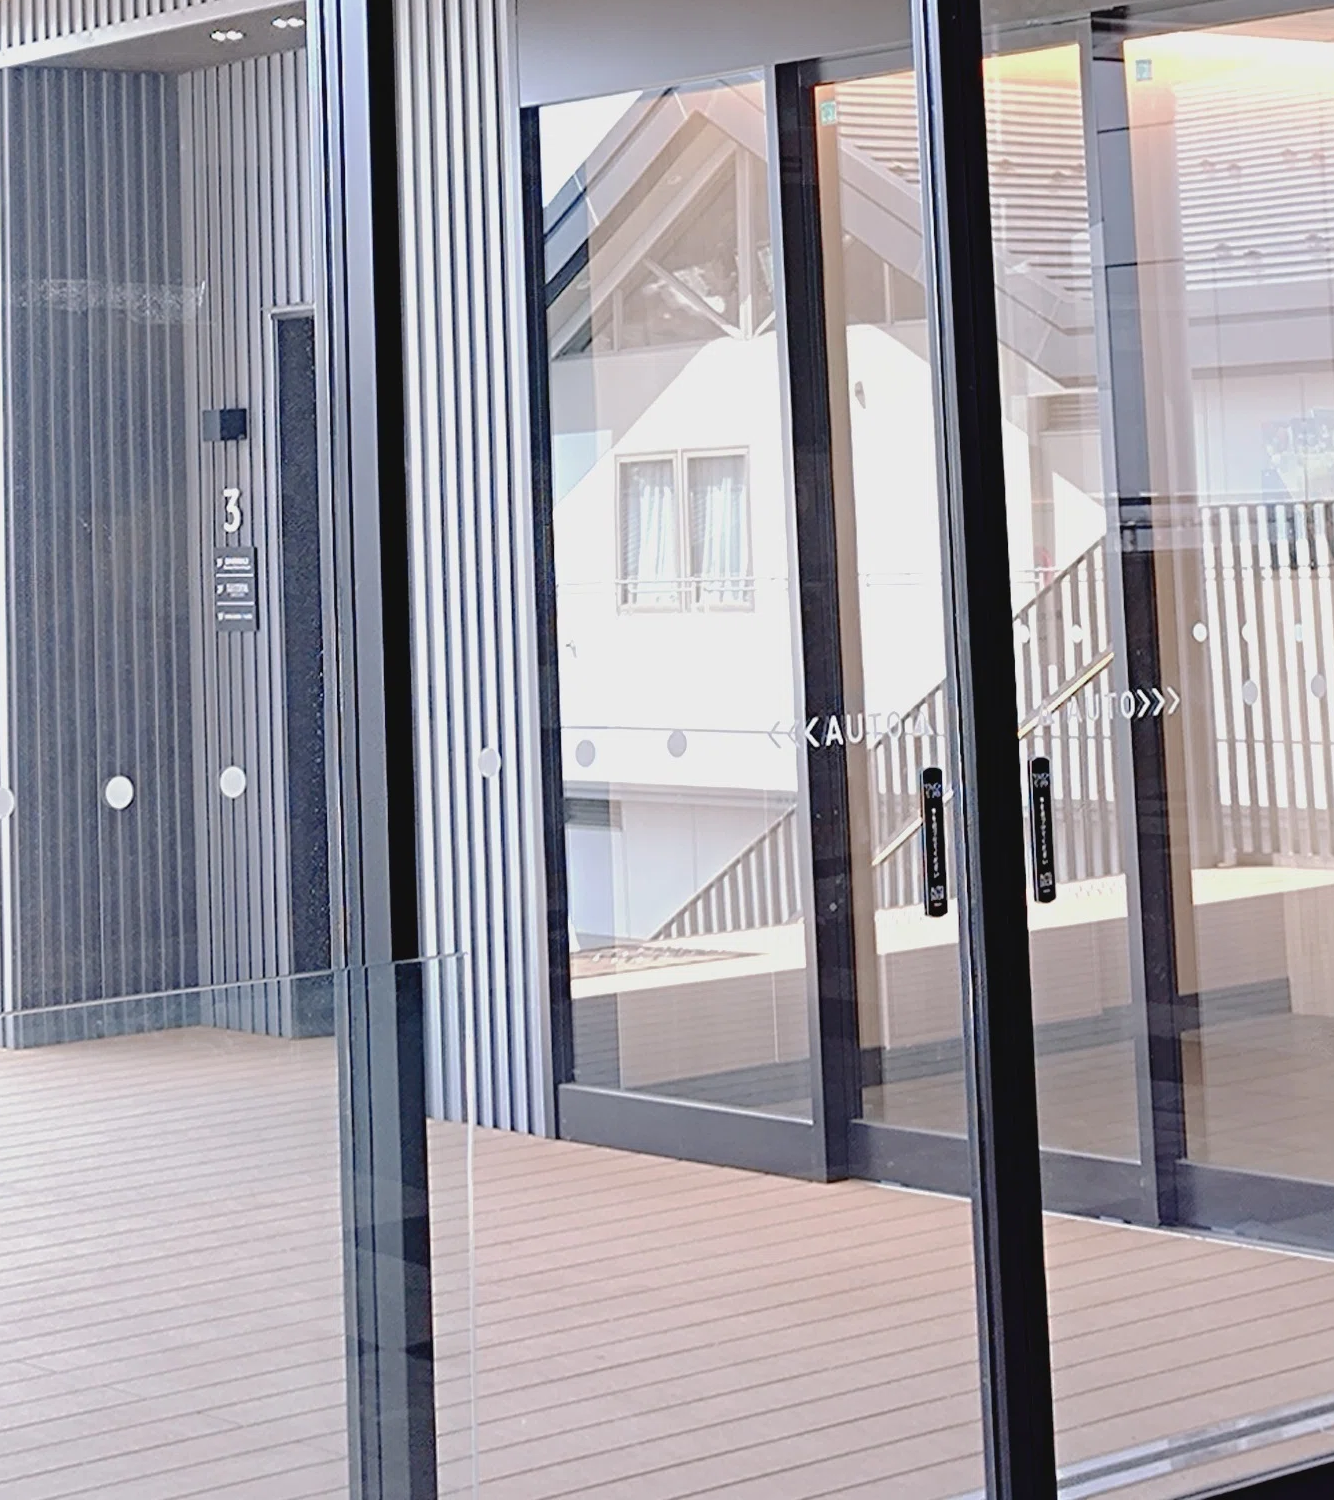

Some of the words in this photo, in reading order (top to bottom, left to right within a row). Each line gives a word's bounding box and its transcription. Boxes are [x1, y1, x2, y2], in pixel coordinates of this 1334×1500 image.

[222, 487, 242, 533] 3
[1066, 689, 1136, 724] AUTO
[825, 711, 903, 747] AUTO
